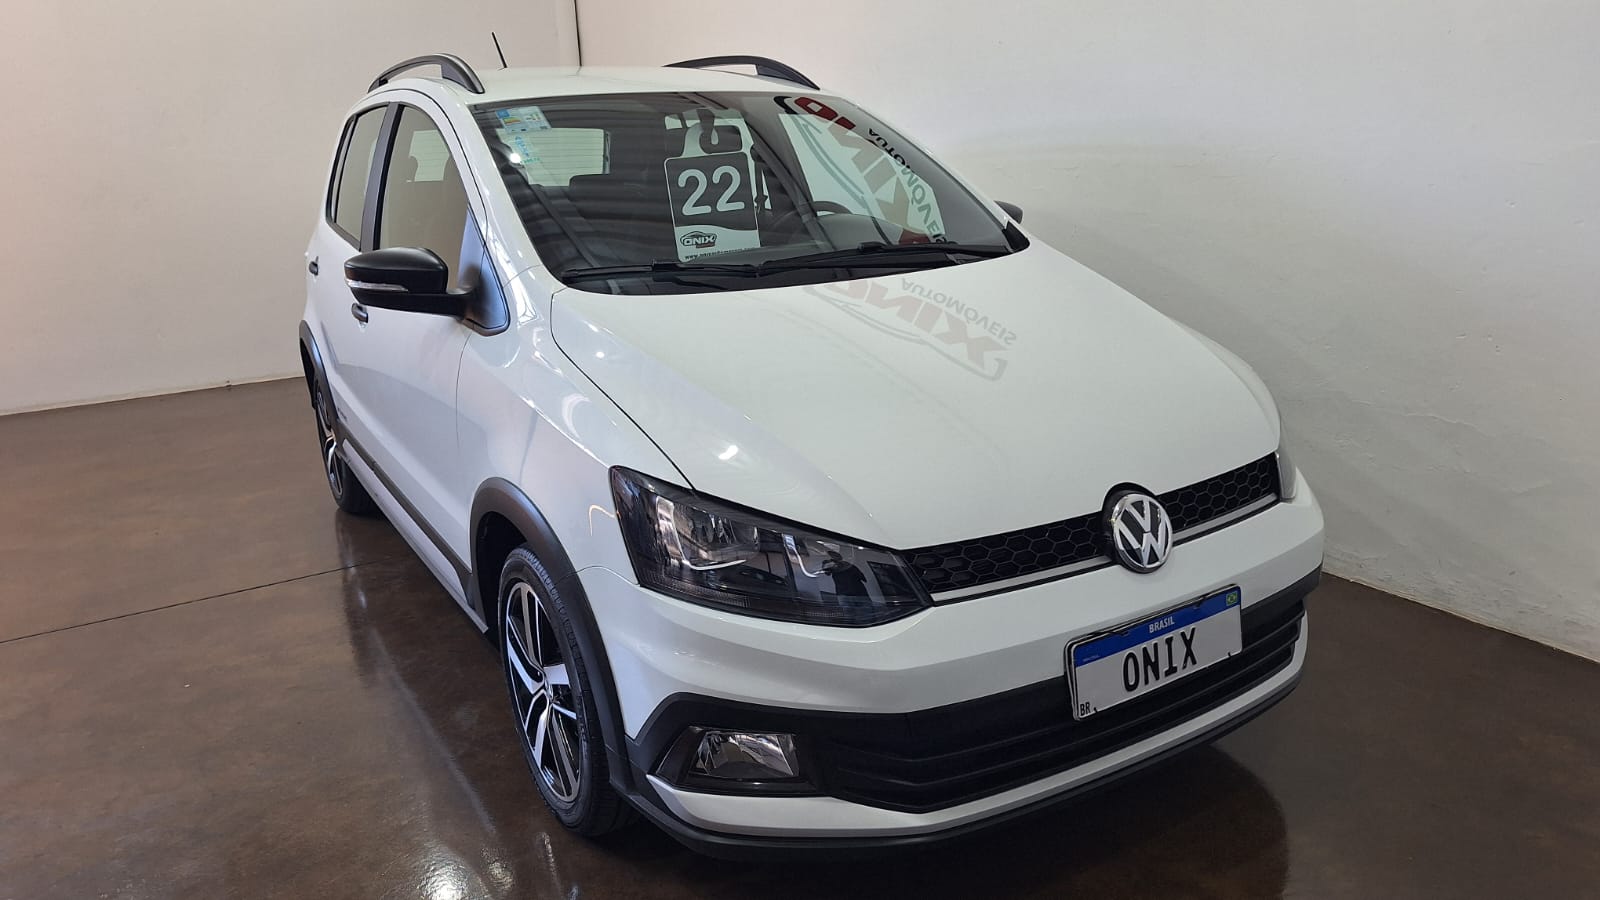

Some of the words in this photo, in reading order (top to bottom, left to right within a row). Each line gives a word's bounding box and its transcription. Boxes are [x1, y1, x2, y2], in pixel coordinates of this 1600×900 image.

[677, 166, 746, 216] 22
[683, 234, 716, 246] ONIX
[1148, 616, 1176, 634] BRASIL
[1122, 626, 1198, 692] ONIX
[1079, 701, 1092, 717] BR
